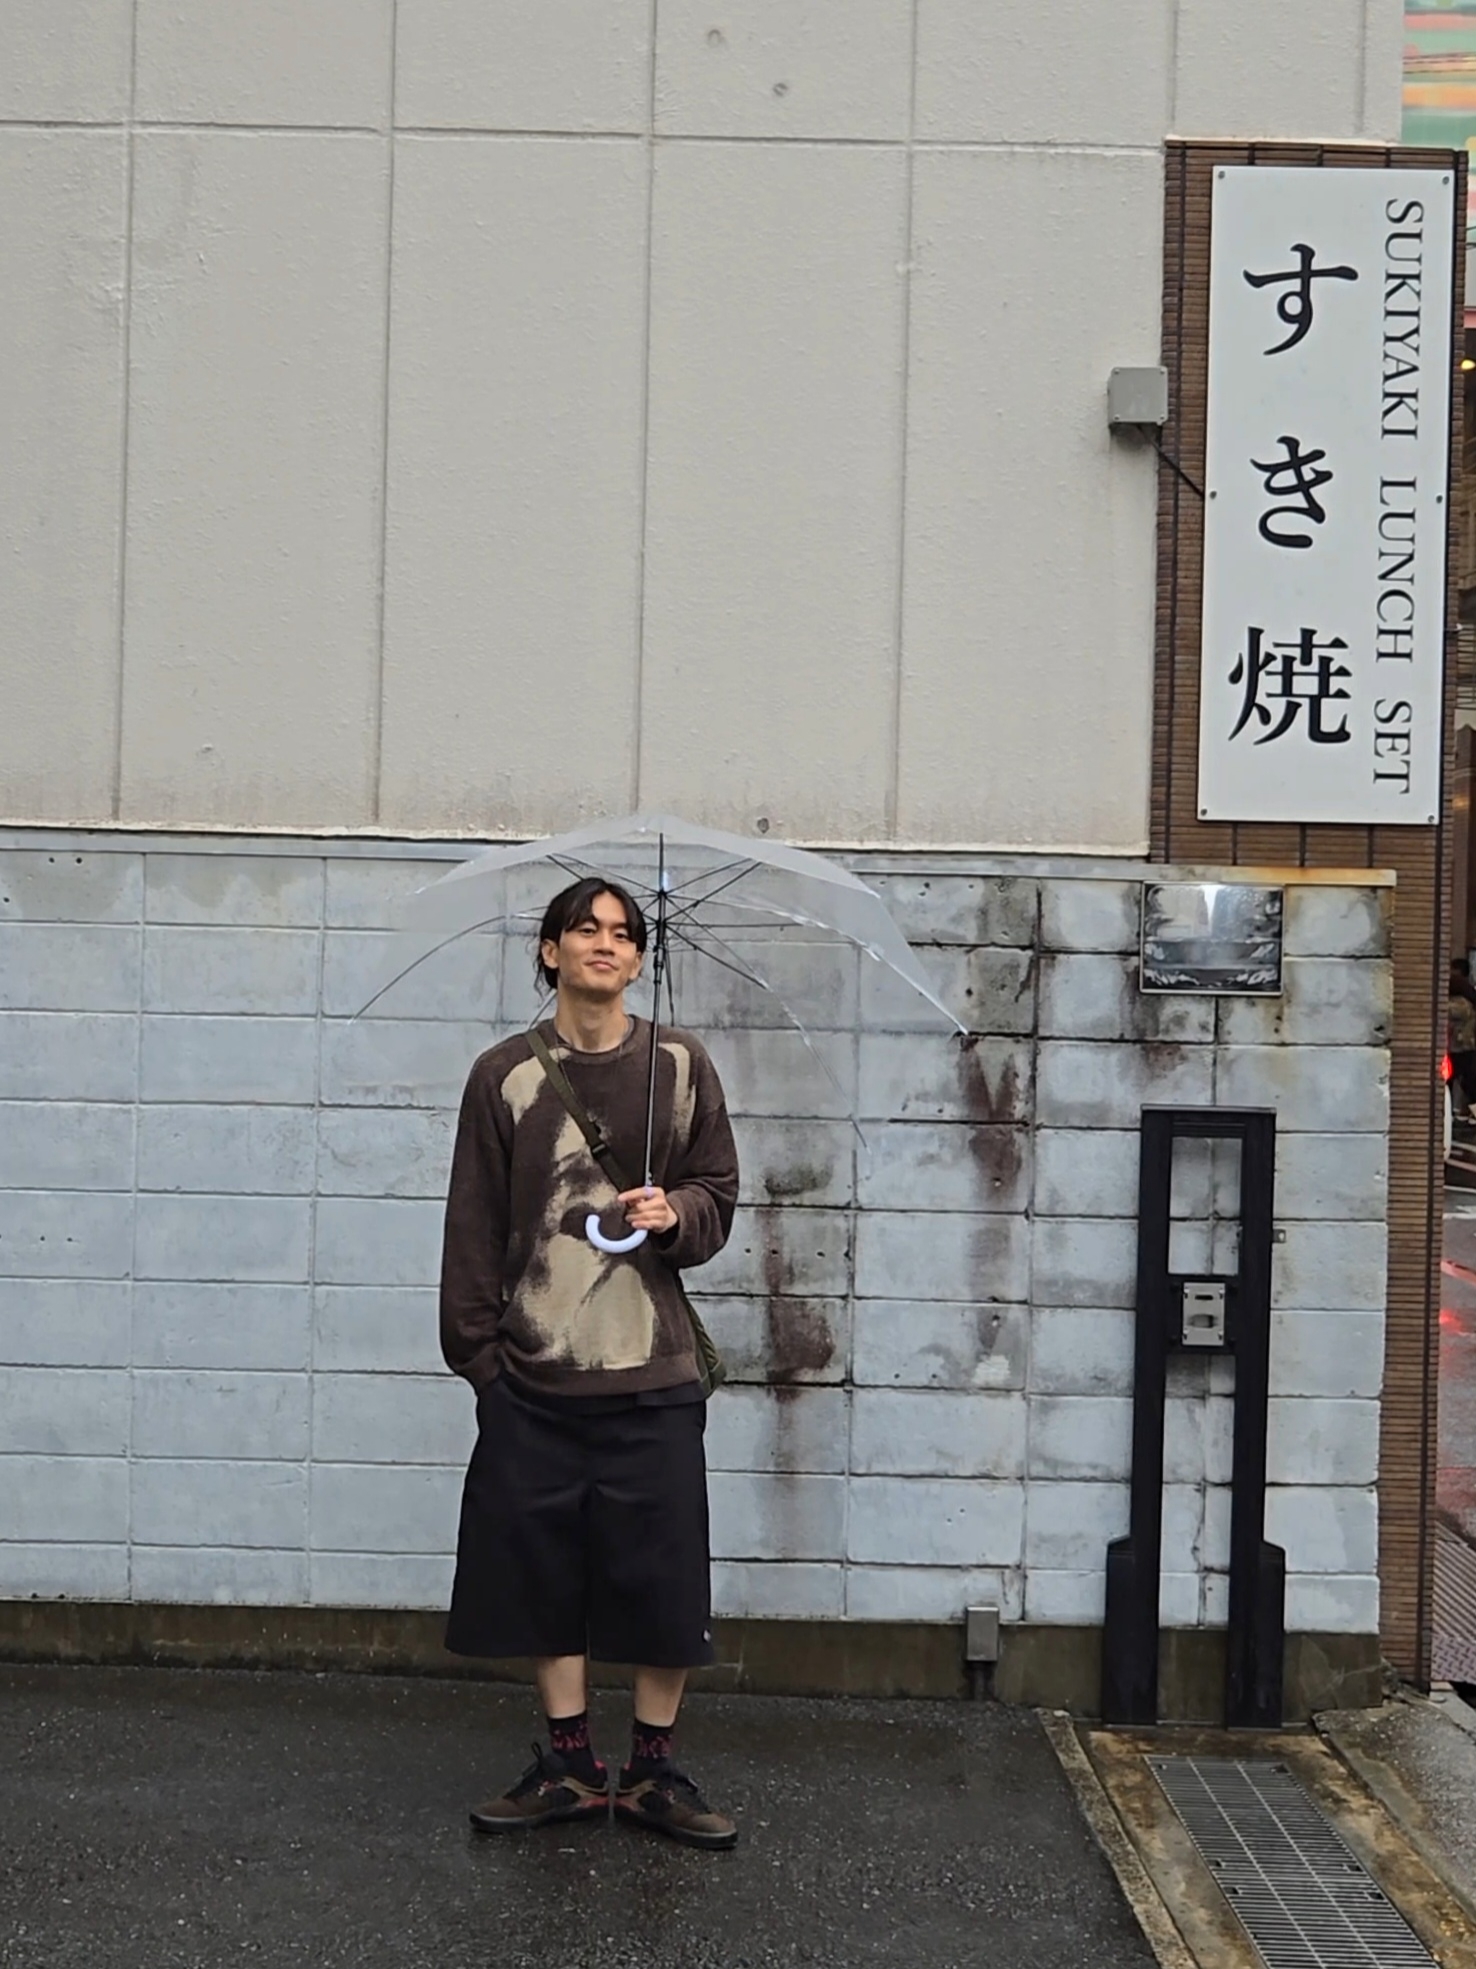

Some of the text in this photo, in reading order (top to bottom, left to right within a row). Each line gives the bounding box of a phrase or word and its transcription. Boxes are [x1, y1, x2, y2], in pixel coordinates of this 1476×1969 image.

[1228, 243, 1359, 745] すき焼
[1373, 198, 1424, 794] SUKIYAKI LUNCH SET
